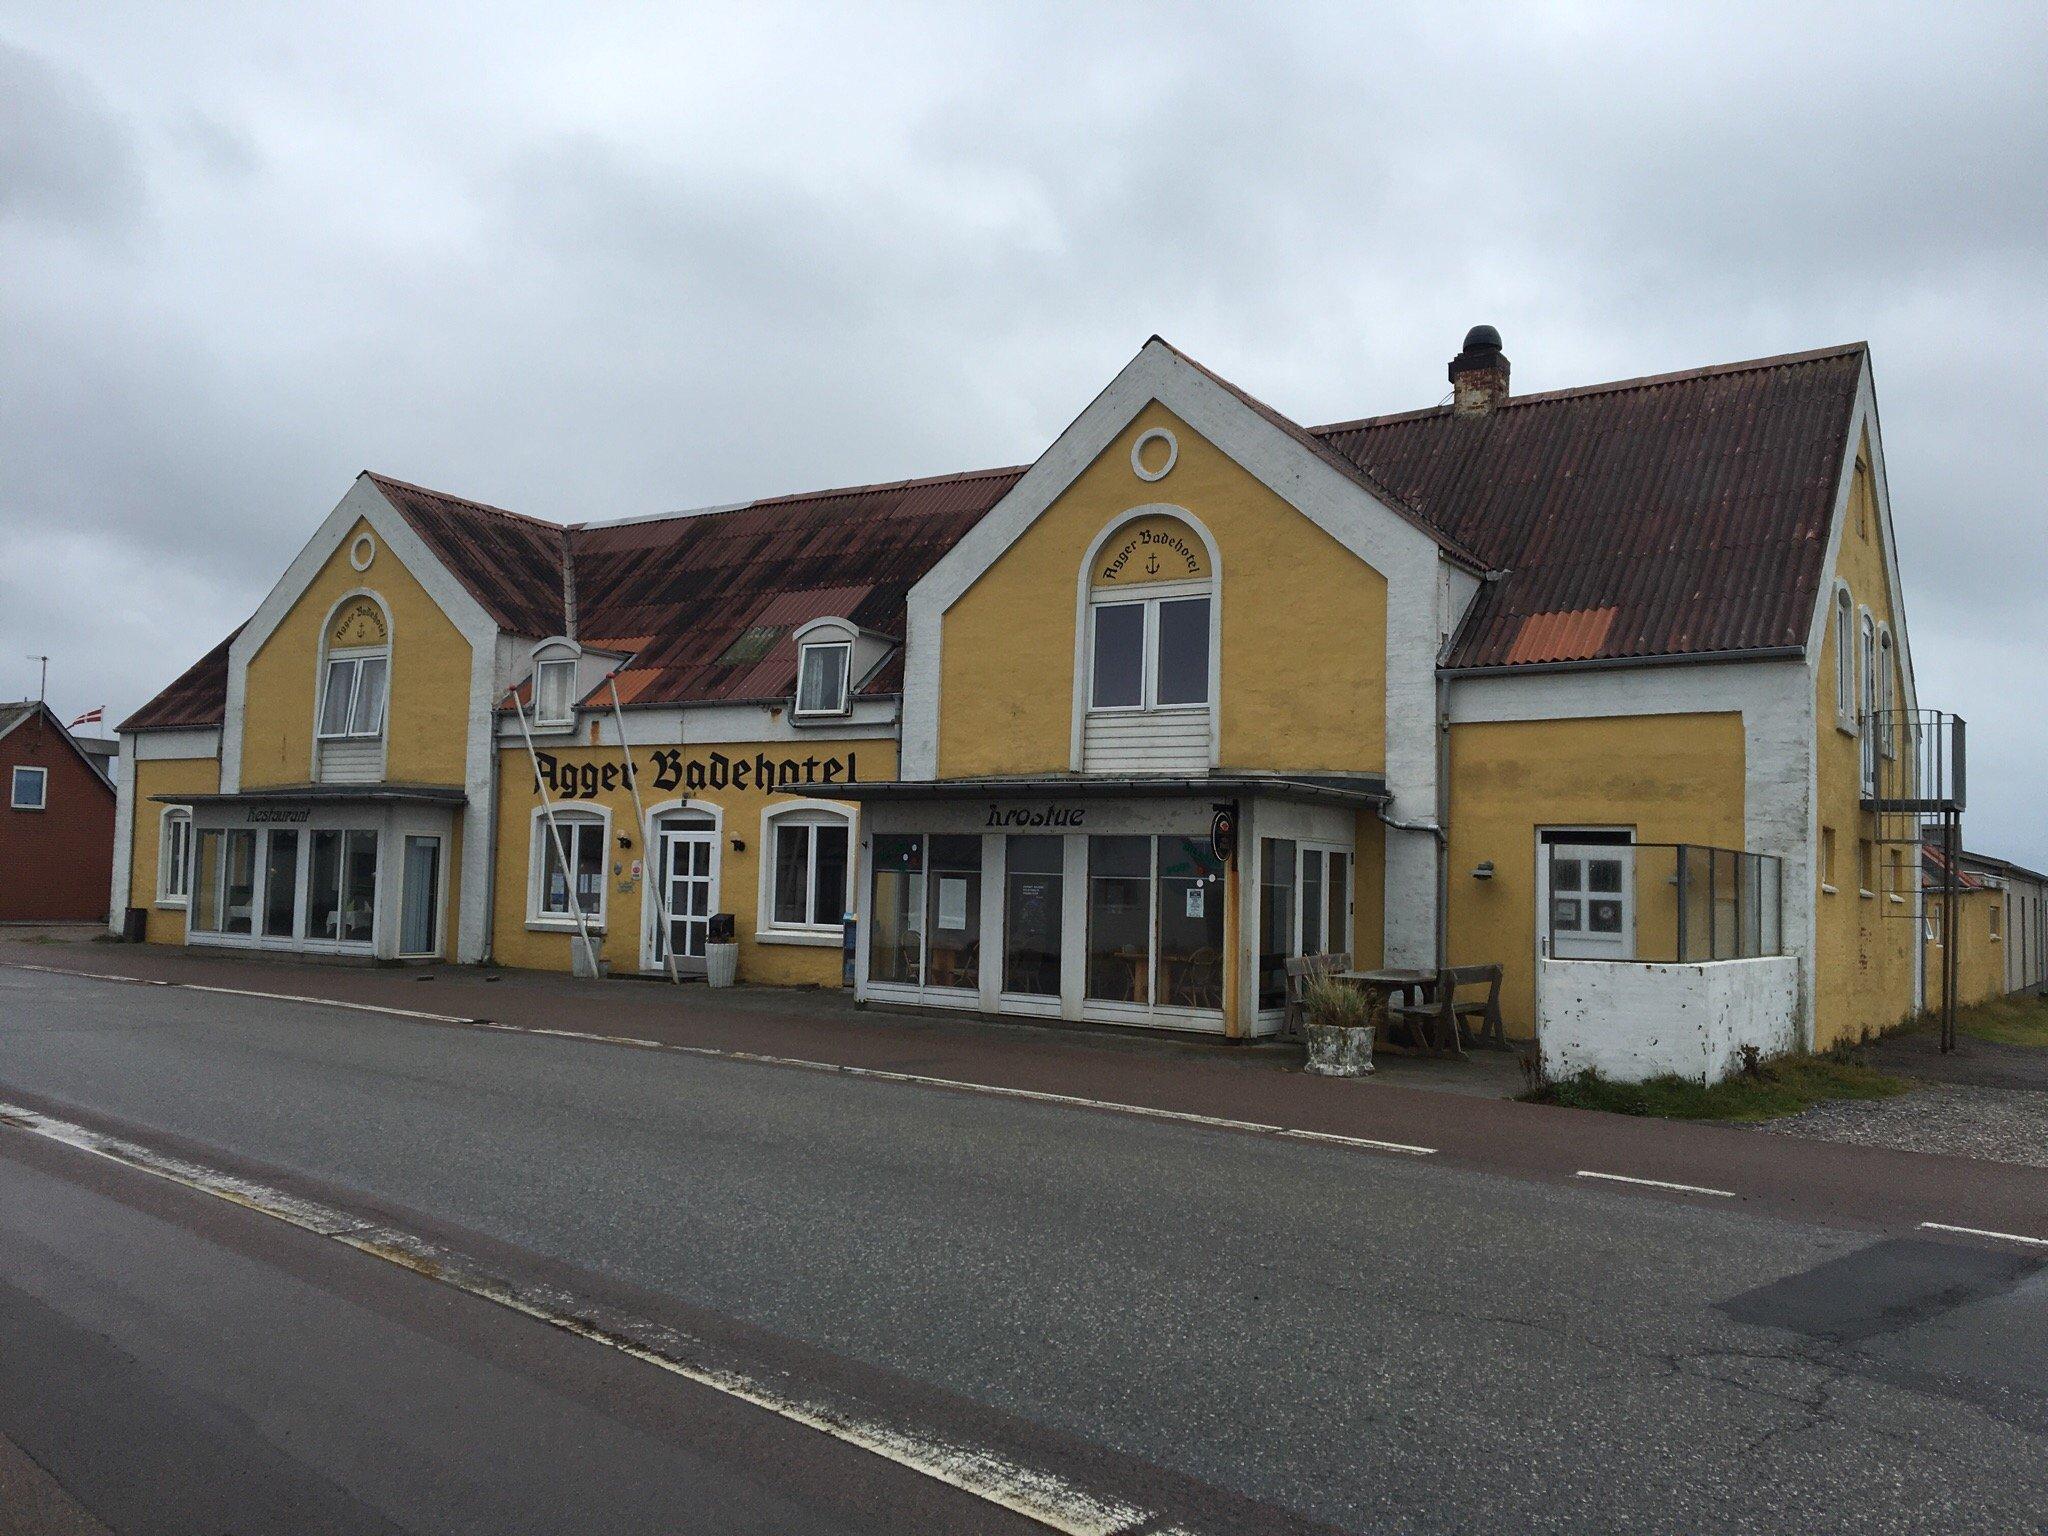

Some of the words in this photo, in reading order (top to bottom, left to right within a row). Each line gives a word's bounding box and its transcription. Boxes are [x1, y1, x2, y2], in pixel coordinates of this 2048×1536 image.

[1103, 541, 1137, 580] Agger
[1139, 529, 1200, 574] Badehotel
[335, 613, 355, 640] Agger
[533, 750, 638, 799] Agger
[650, 748, 857, 795] Badehotel
[246, 806, 311, 823] Restaurant
